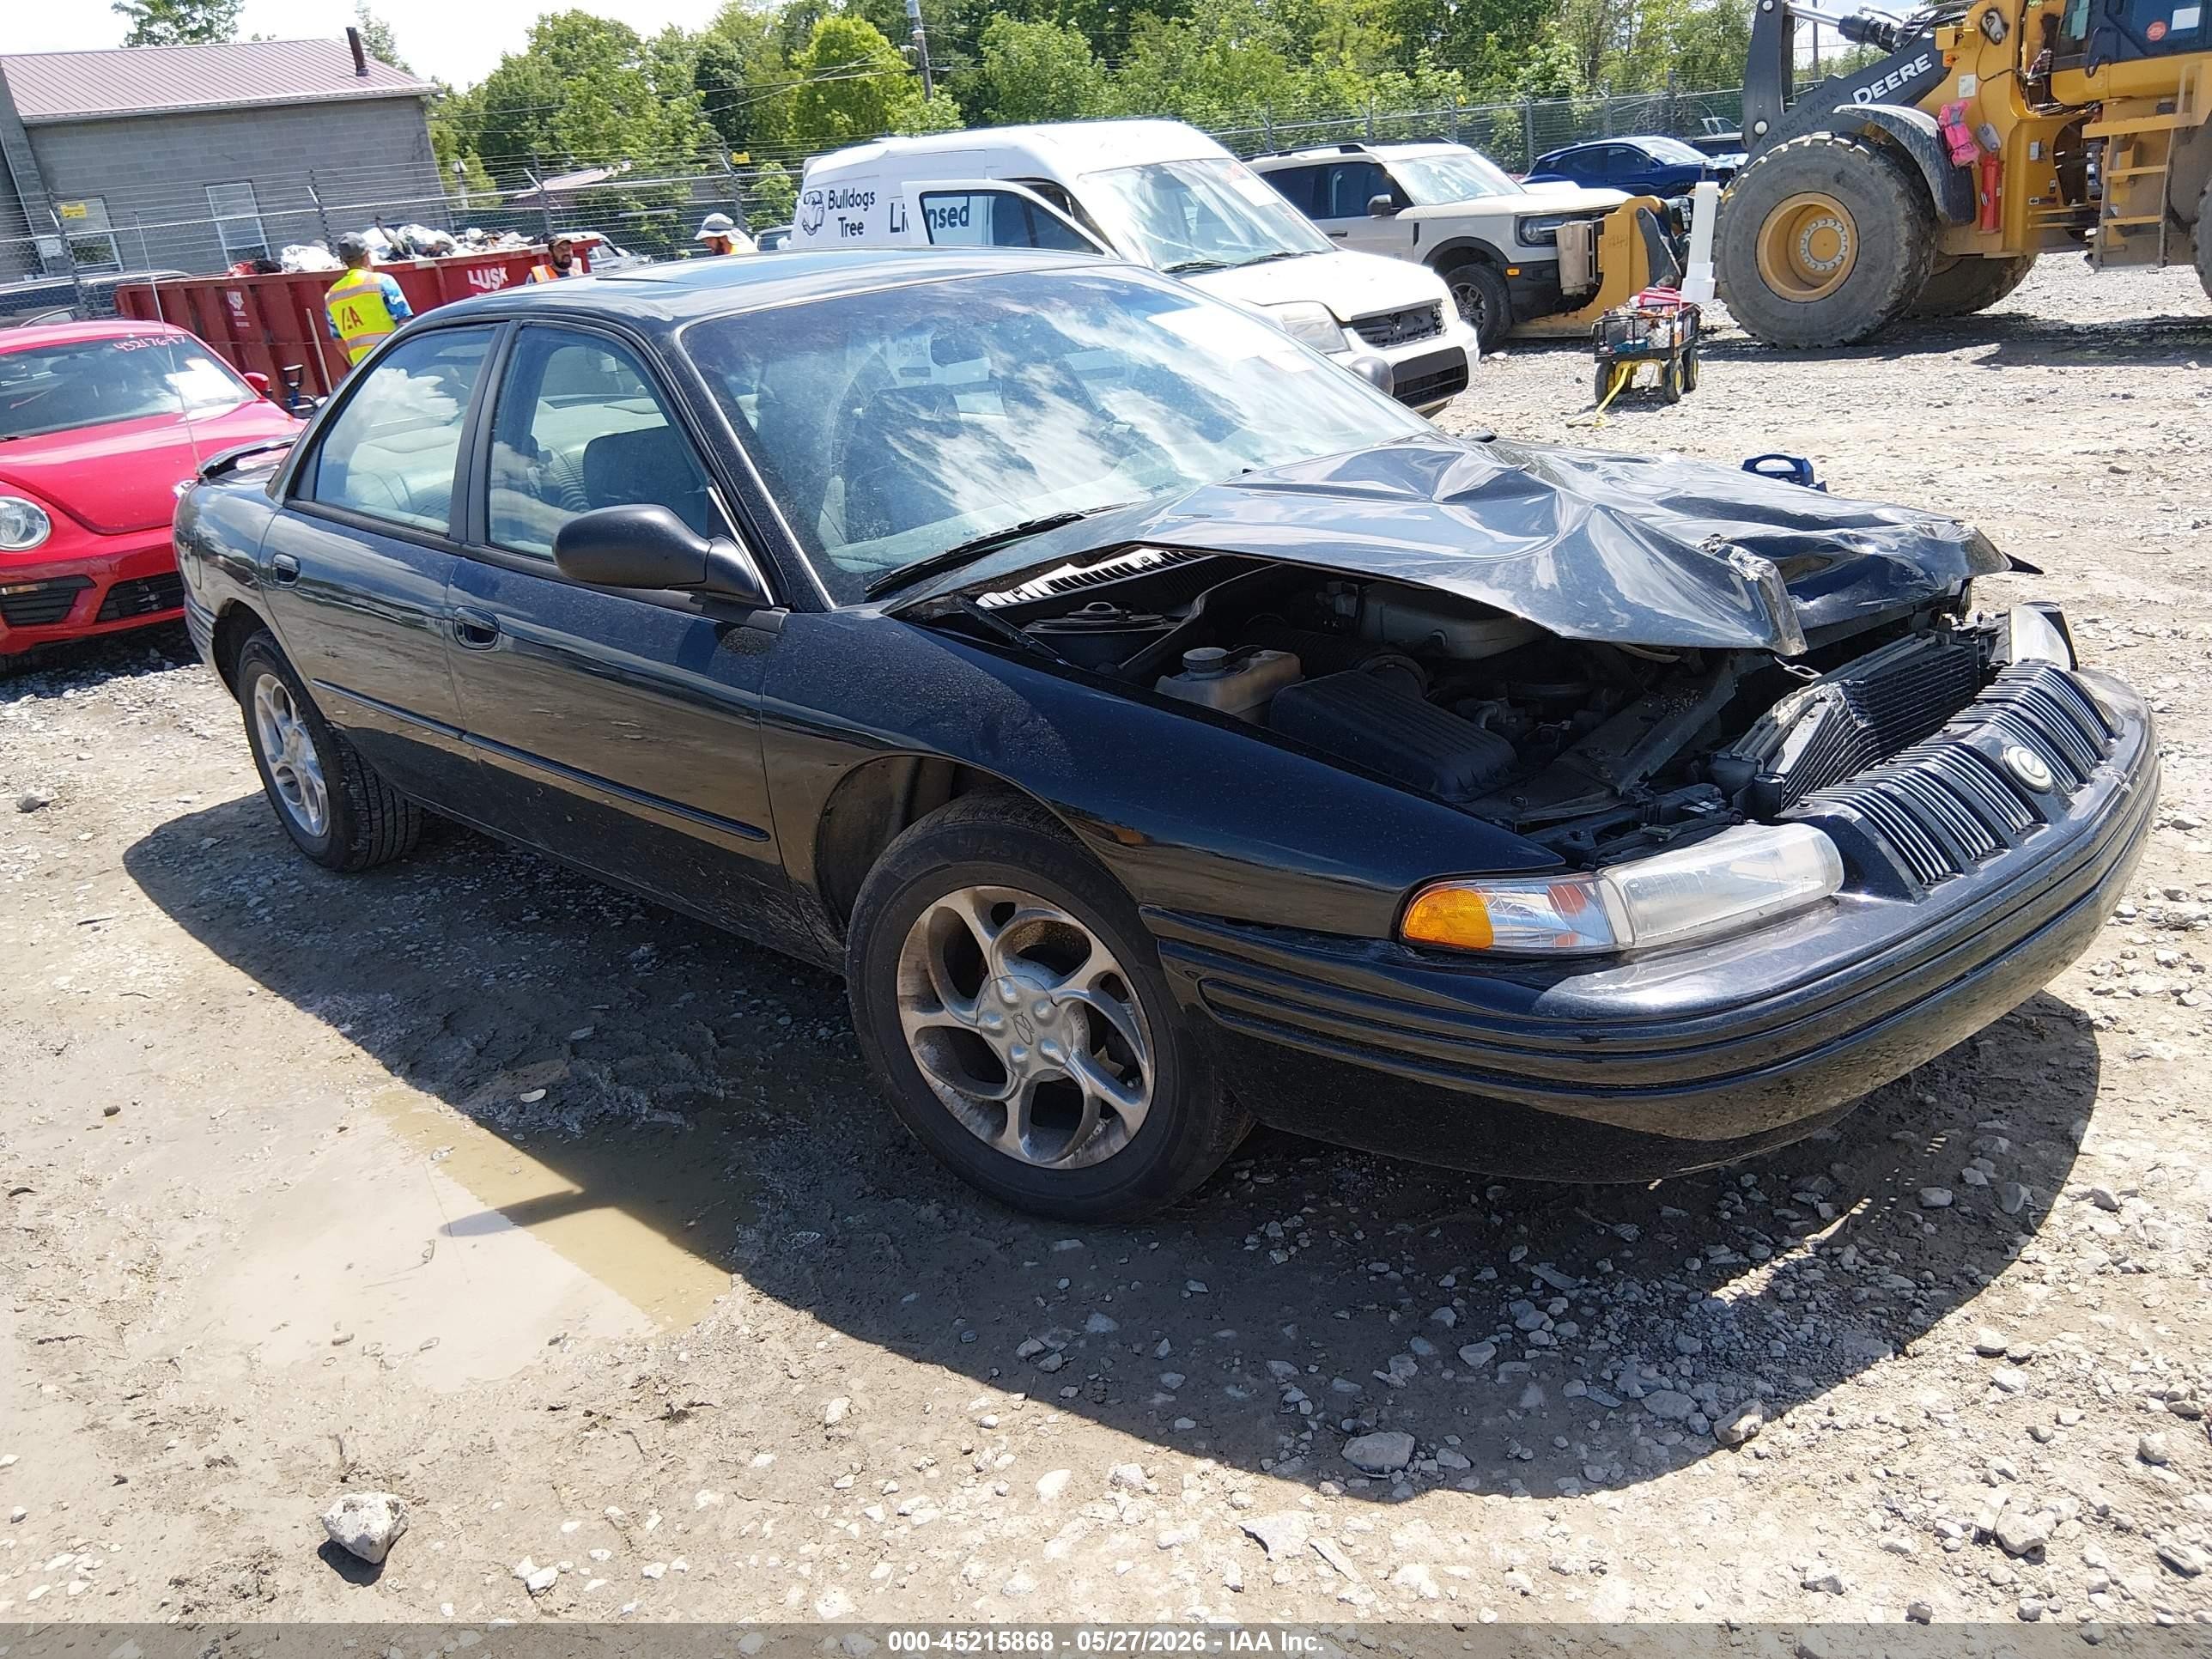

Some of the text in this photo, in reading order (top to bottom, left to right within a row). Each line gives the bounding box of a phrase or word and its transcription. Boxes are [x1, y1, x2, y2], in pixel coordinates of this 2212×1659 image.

[1852, 52, 1933, 104] DEERE
[828, 188, 876, 211] Bulldogs
[890, 196, 969, 234] Linsed
[837, 216, 865, 238] Tree
[467, 267, 509, 289] LUSK
